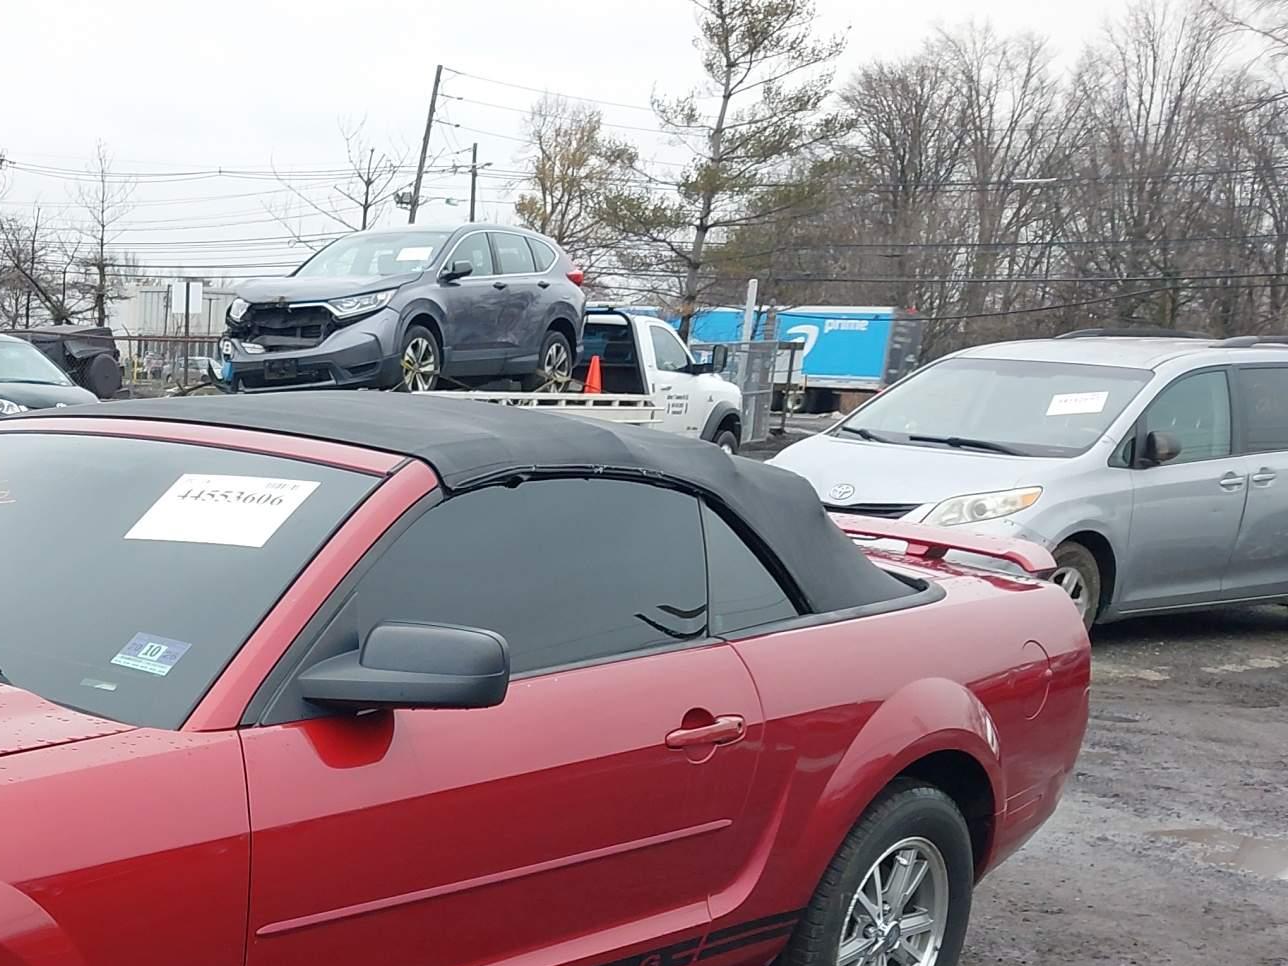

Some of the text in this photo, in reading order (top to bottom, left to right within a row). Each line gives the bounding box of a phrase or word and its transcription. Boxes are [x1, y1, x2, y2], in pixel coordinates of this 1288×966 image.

[823, 316, 869, 334] prime
[176, 487, 285, 507] 44553606
[141, 644, 162, 658] 10
